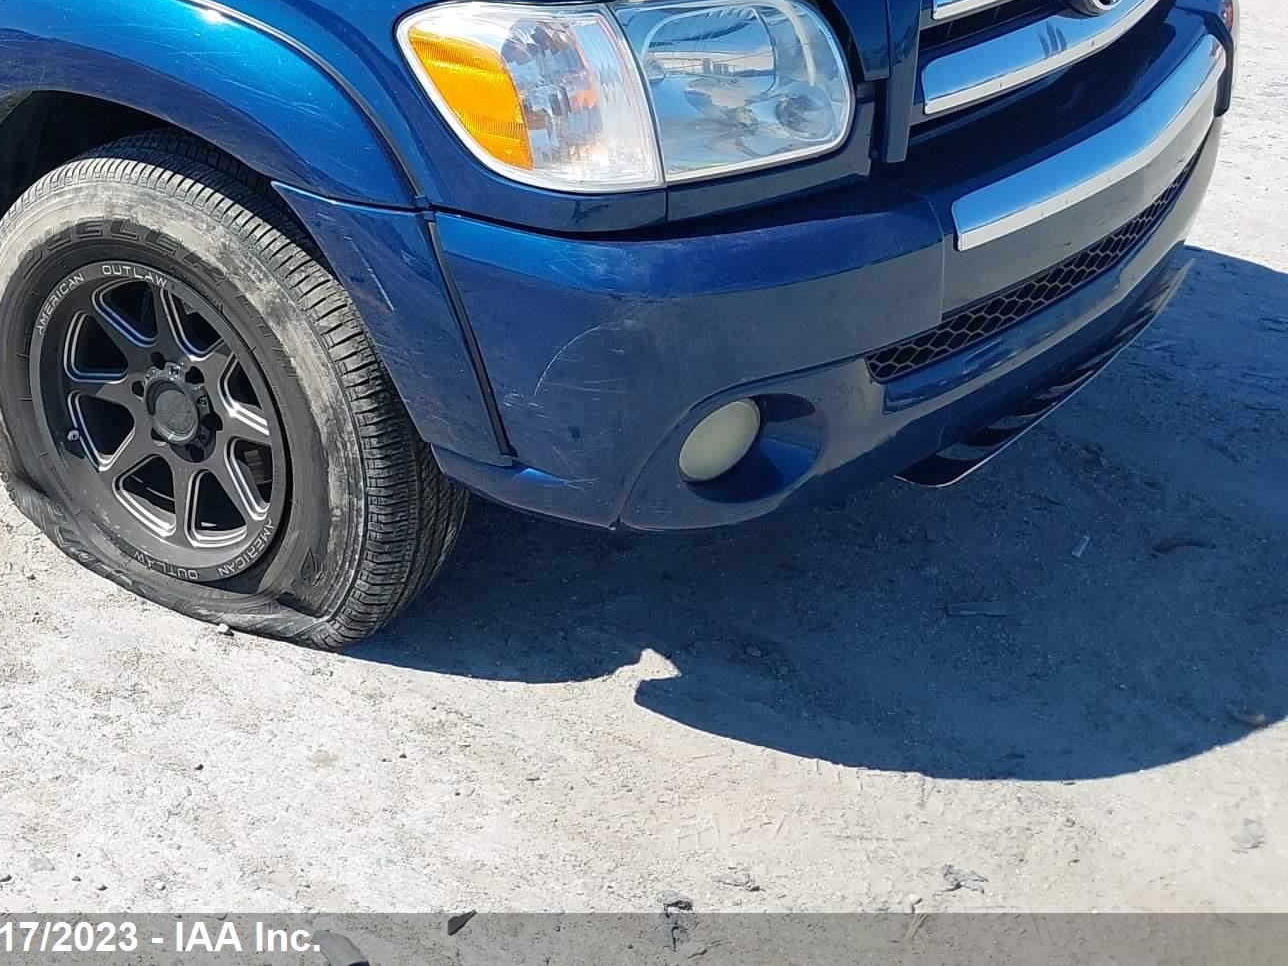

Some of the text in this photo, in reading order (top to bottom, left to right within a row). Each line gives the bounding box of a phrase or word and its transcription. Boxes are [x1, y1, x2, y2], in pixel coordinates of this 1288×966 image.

[35, 265, 168, 335] AMERICAN OUTLAW
[133, 518, 274, 580] AMERICAN OUTLAW
